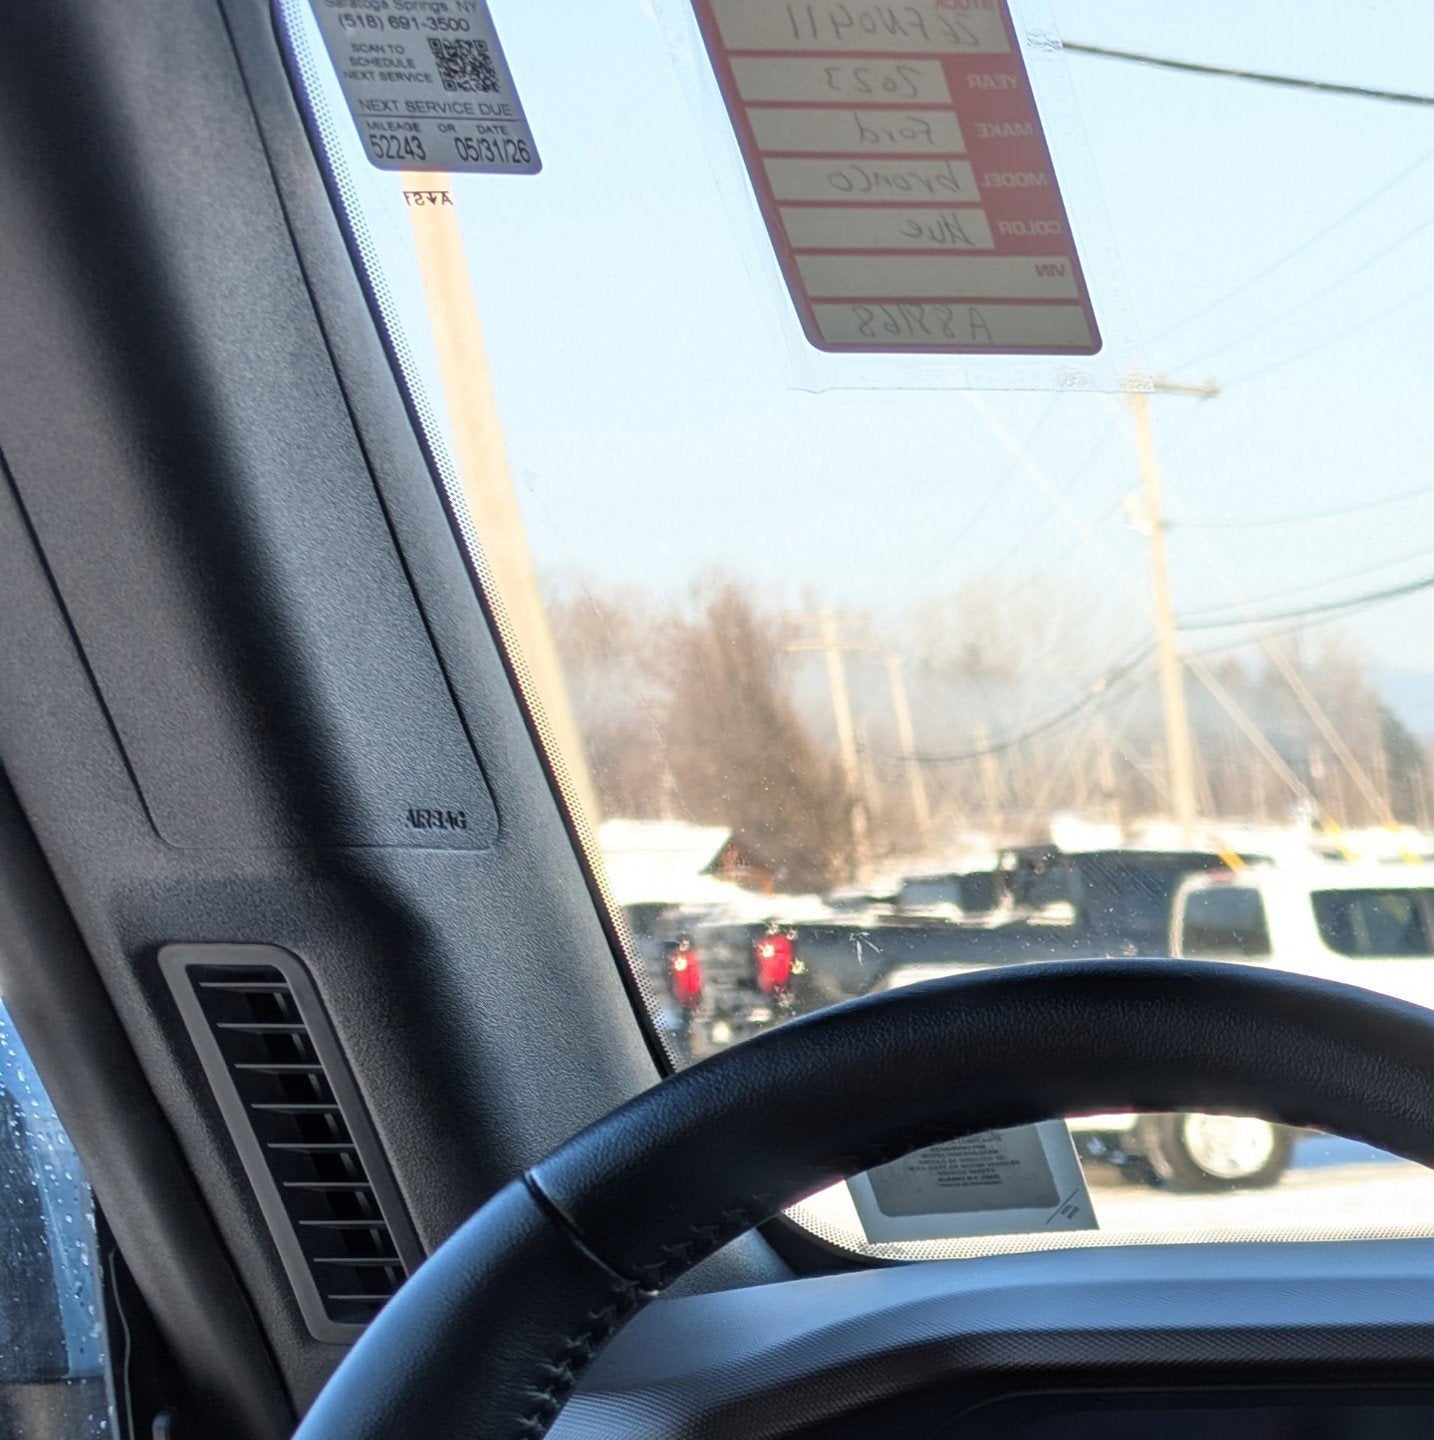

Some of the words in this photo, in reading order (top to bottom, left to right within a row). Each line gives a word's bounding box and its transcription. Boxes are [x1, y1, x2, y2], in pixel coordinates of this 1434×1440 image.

[338, 13, 385, 31] (518)
[388, 15, 470, 32] 691-3500
[351, 44, 385, 54] SCAN
[389, 45, 405, 55] TO
[349, 57, 416, 68] SCHEDULE
[379, 72, 434, 83] SERVICE
[359, 99, 400, 113] NEXT
[406, 101, 475, 115] SERVICE
[480, 102, 513, 116] DUE
[367, 121, 422, 132] MILEAGE
[438, 124, 457, 134] OR
[477, 125, 509, 135] DATE
[368, 134, 427, 161] 52243
[454, 136, 532, 164] 05/31/26
[405, 808, 467, 830] AIRBAG
